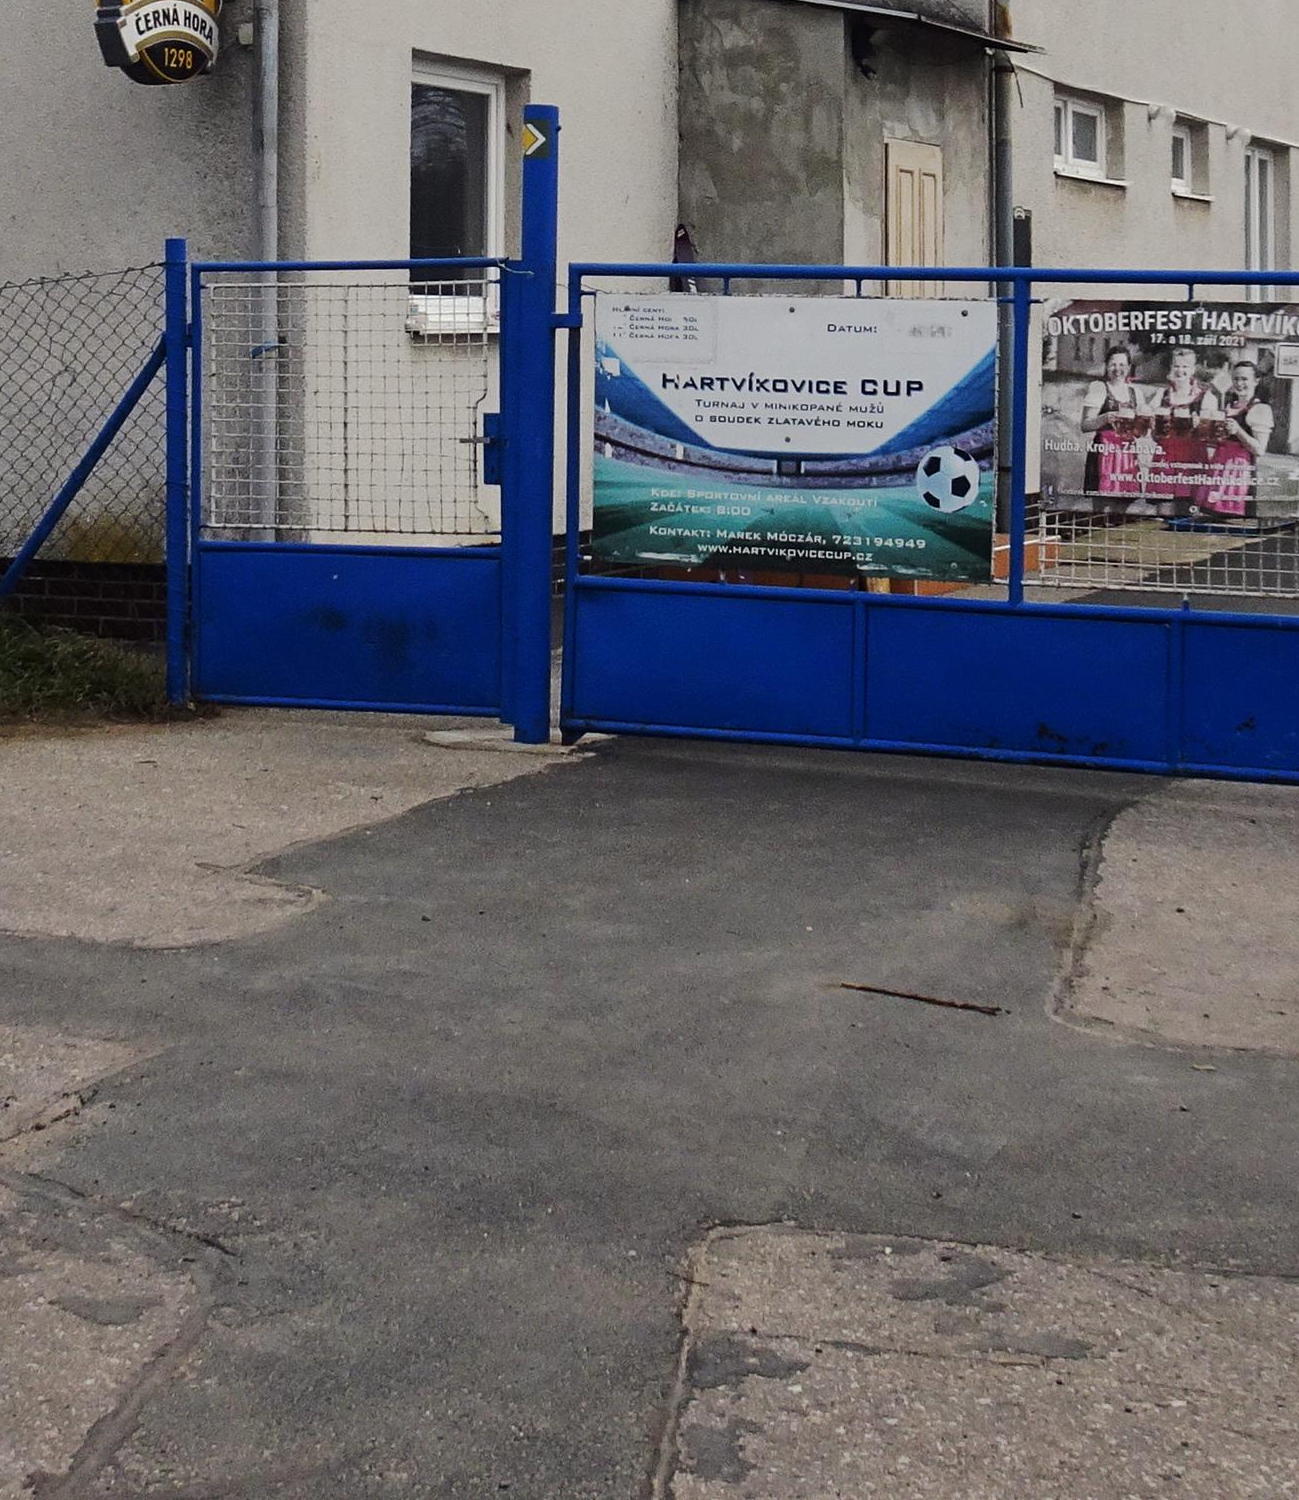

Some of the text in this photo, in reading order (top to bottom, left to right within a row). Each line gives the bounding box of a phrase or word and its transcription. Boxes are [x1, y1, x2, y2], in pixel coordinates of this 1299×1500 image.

[135, 3, 214, 46] ČERNÁ HORA
[164, 47, 193, 69] 1298
[1048, 310, 1198, 336] OKTOBERFEST
[1150, 332, 1166, 344] 17.
[1169, 335, 1176, 344] a
[1179, 333, 1195, 345] 18.
[1219, 335, 1245, 347] 2021
[661, 371, 924, 397] HARTVÍKOVICE CUP
[1044, 439, 1083, 453] Hudba.
[716, 504, 751, 516] 8:00
[832, 534, 926, 549] 723194949
